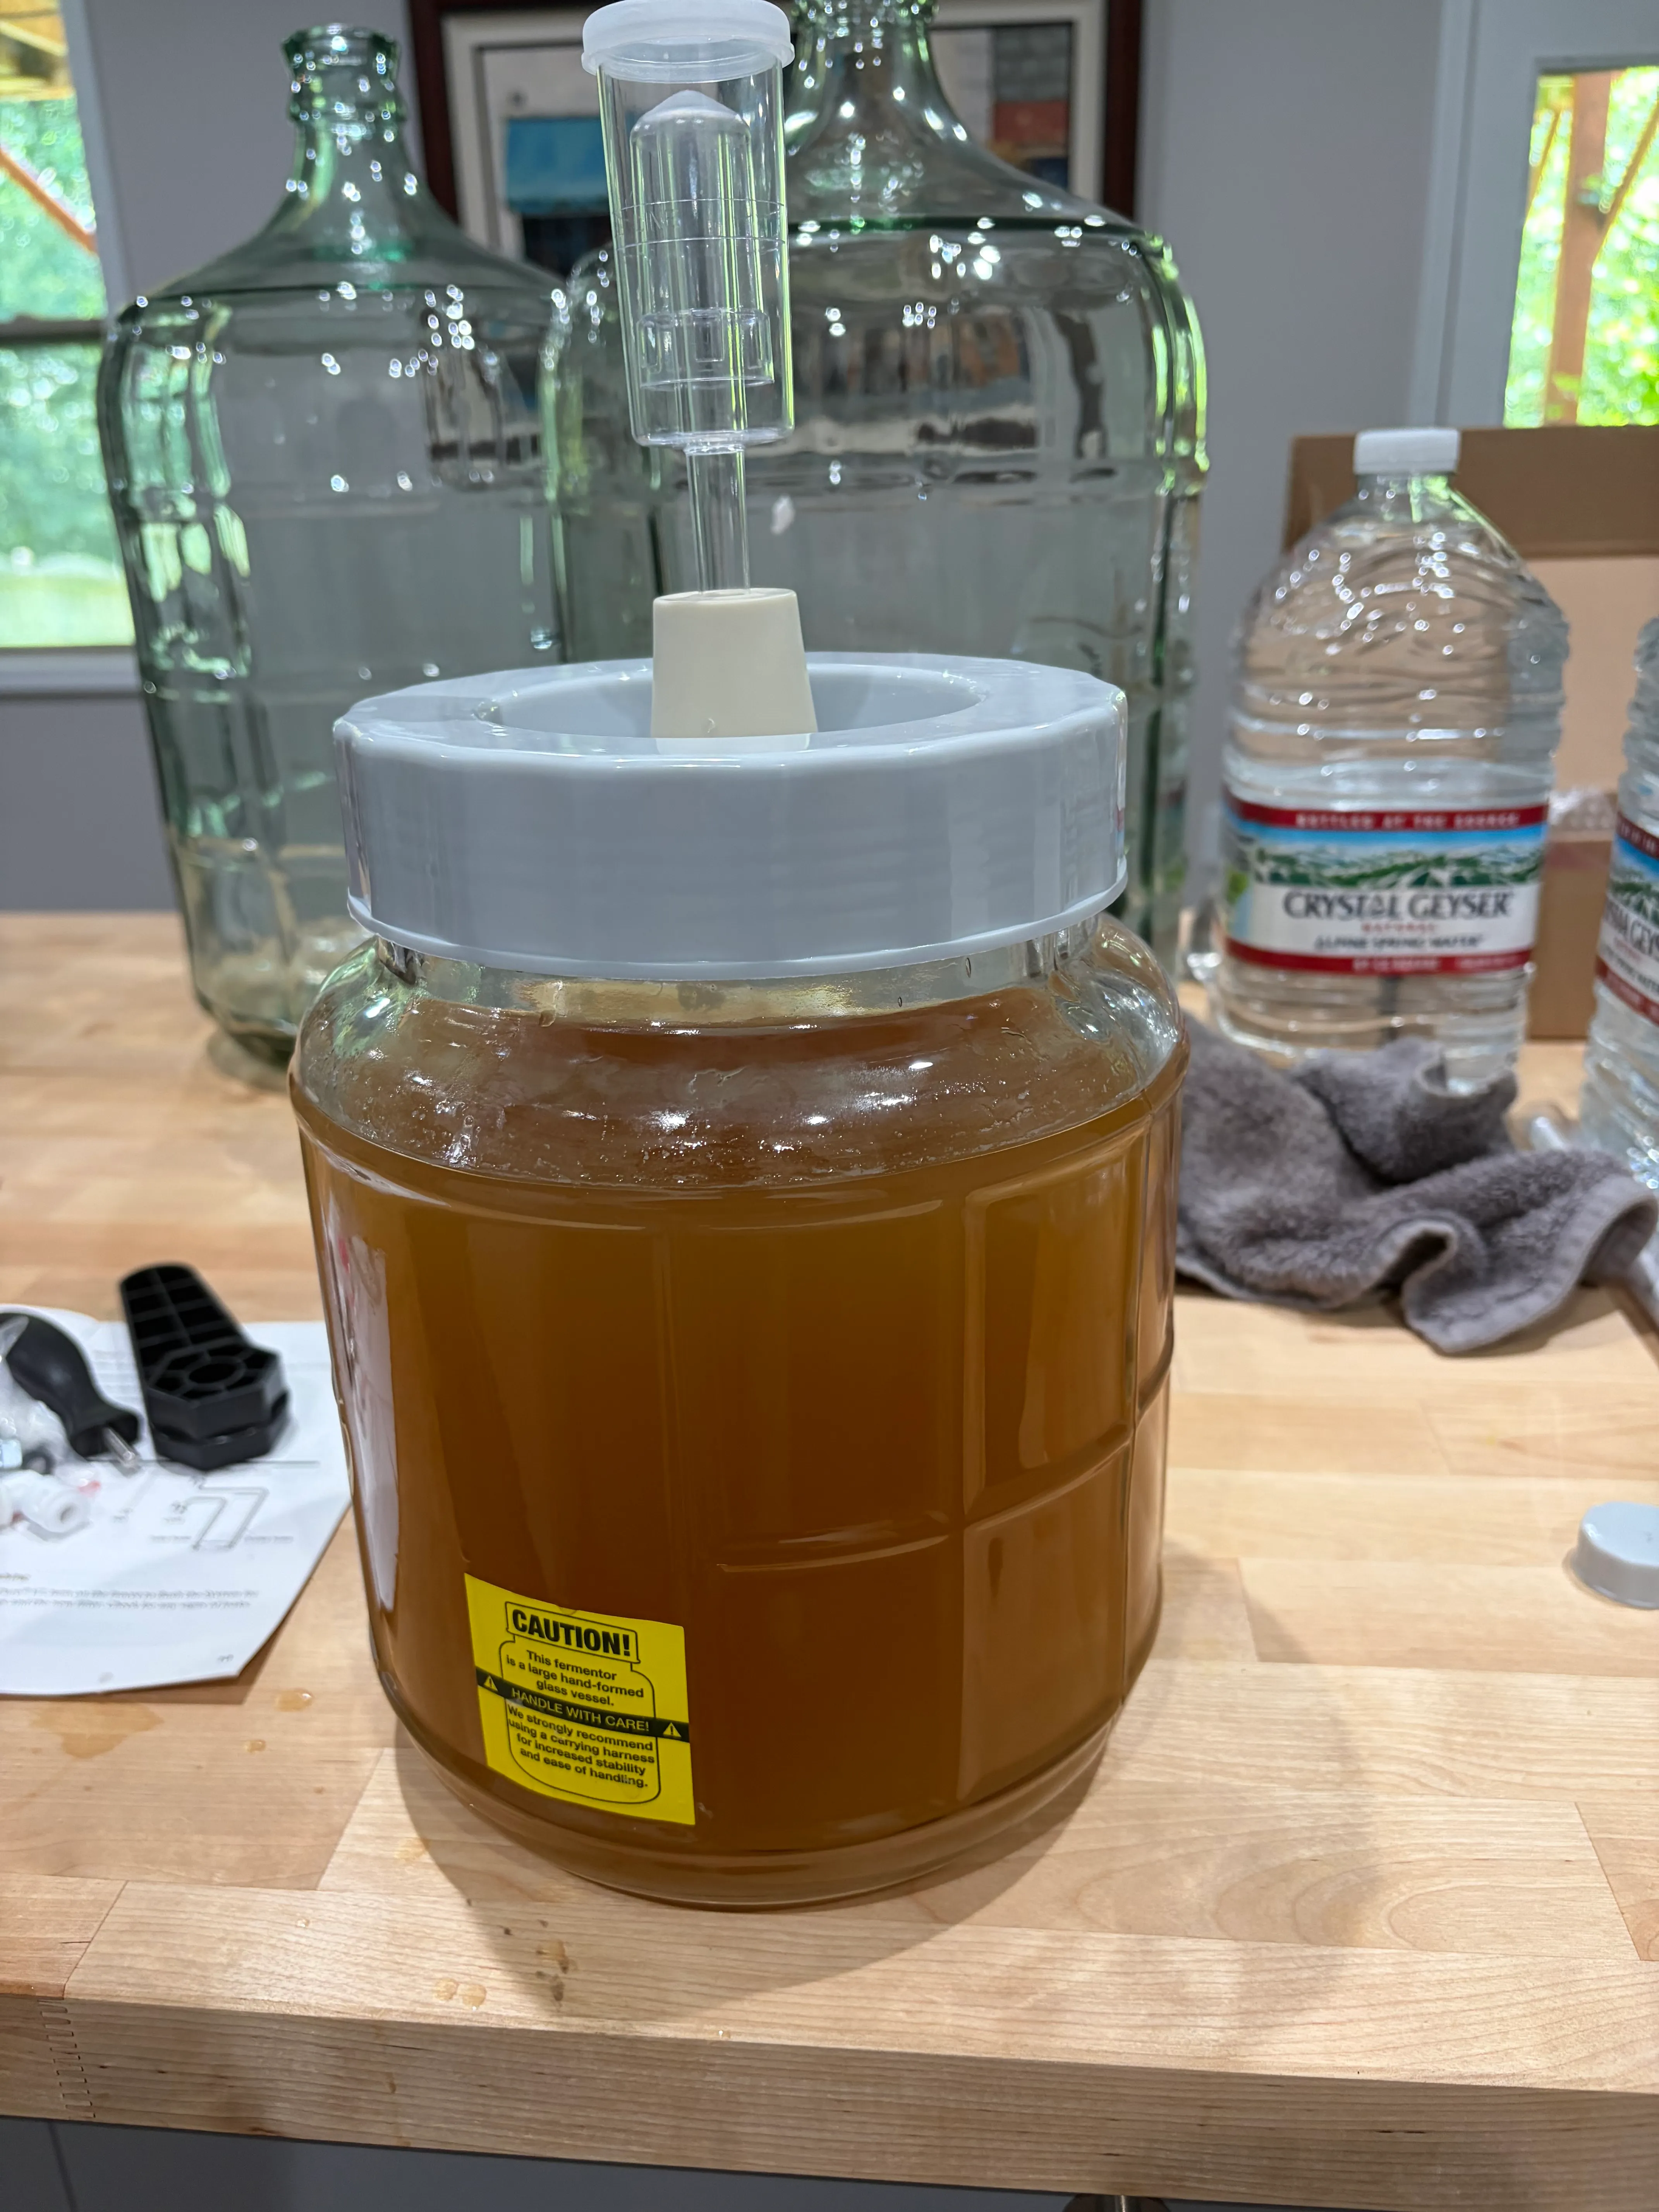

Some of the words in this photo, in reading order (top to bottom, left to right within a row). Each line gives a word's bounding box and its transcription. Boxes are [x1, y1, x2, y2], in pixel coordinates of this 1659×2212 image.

[1283, 891, 1400, 921] CRYSTAL
[1409, 891, 1511, 919] GEYSER
[512, 1609, 630, 1656] CAUTION!
[507, 1654, 516, 1666] is
[529, 1662, 557, 1680] large
[561, 1672, 644, 1698] hand-formed
[526, 1649, 551, 1666] This
[554, 1658, 617, 1680] fermentor
[512, 1687, 563, 1714] HANDLE
[566, 1705, 601, 1724] WITH
[605, 1716, 649, 1731] CARE!
[537, 1680, 567, 1695] glass
[570, 1690, 614, 1706] vessel.
[508, 1704, 524, 1719] We
[527, 1714, 573, 1737] strongly
[577, 1730, 653, 1751] recommend
[508, 1719, 537, 1738] using
[540, 1731, 547, 1740] a
[551, 1735, 599, 1756] carrying
[603, 1746, 655, 1763] harness
[517, 1733, 532, 1747] for
[535, 1740, 593, 1765] increased
[596, 1759, 646, 1776] stability
[520, 1748, 540, 1762] and
[543, 1757, 571, 1770] ease
[574, 1765, 587, 1775] of
[590, 1767, 648, 1788] handling.
